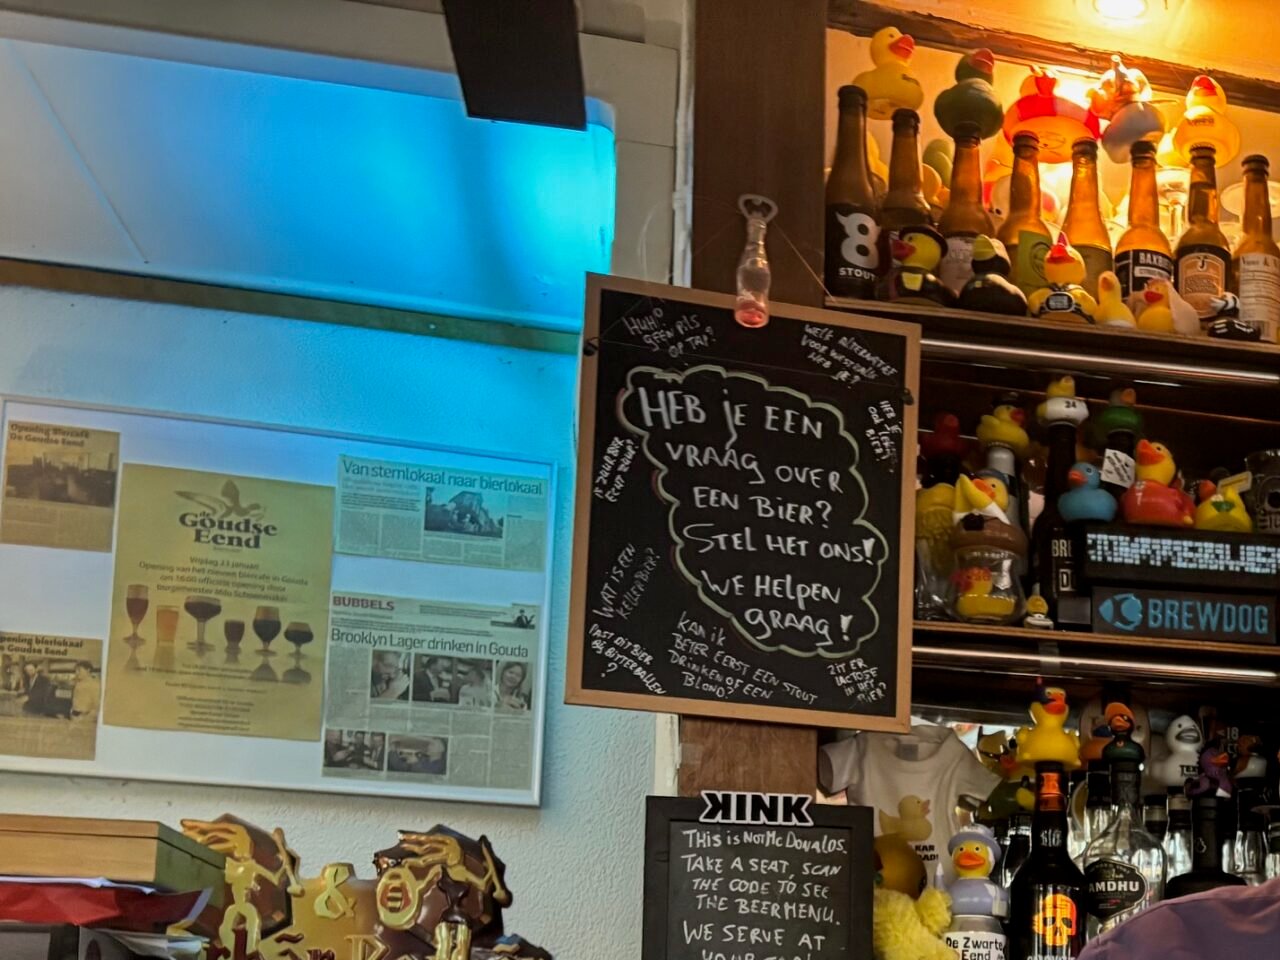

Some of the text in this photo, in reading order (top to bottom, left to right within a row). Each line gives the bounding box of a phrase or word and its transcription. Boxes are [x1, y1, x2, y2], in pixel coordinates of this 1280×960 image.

[838, 266, 877, 282] STOUT
[639, 387, 707, 430] HEB
[765, 406, 823, 439] EEN
[343, 460, 543, 495] Van stemlokaal naar bierlokaal
[775, 465, 843, 494] OVER
[693, 486, 739, 510] EEN
[179, 512, 278, 537] Goudse
[193, 529, 261, 549] Eend
[683, 523, 876, 565] STEL HET ONS!
[139, 561, 174, 573] Opening
[592, 543, 637, 618] WAT EEN
[332, 595, 395, 611] BUBBELS
[701, 570, 841, 610] WE HELPEN
[677, 610, 706, 638] KAN
[1148, 599, 1269, 635] BREWDOG
[331, 628, 529, 658] Brooklyn Lager drinken in Gouda
[589, 624, 615, 639] PAST
[672, 632, 818, 705] BETER EERST EEN STOUT
[742, 684, 774, 700] EEN
[701, 792, 812, 824] KINK
[681, 853, 841, 880] TAKE A SEAT, SCAN
[692, 878, 830, 899] THE CODE TO SEE
[696, 894, 728, 911] THE
[683, 920, 826, 951] WE SERVE AT
[963, 937, 1003, 951] Zwarte
